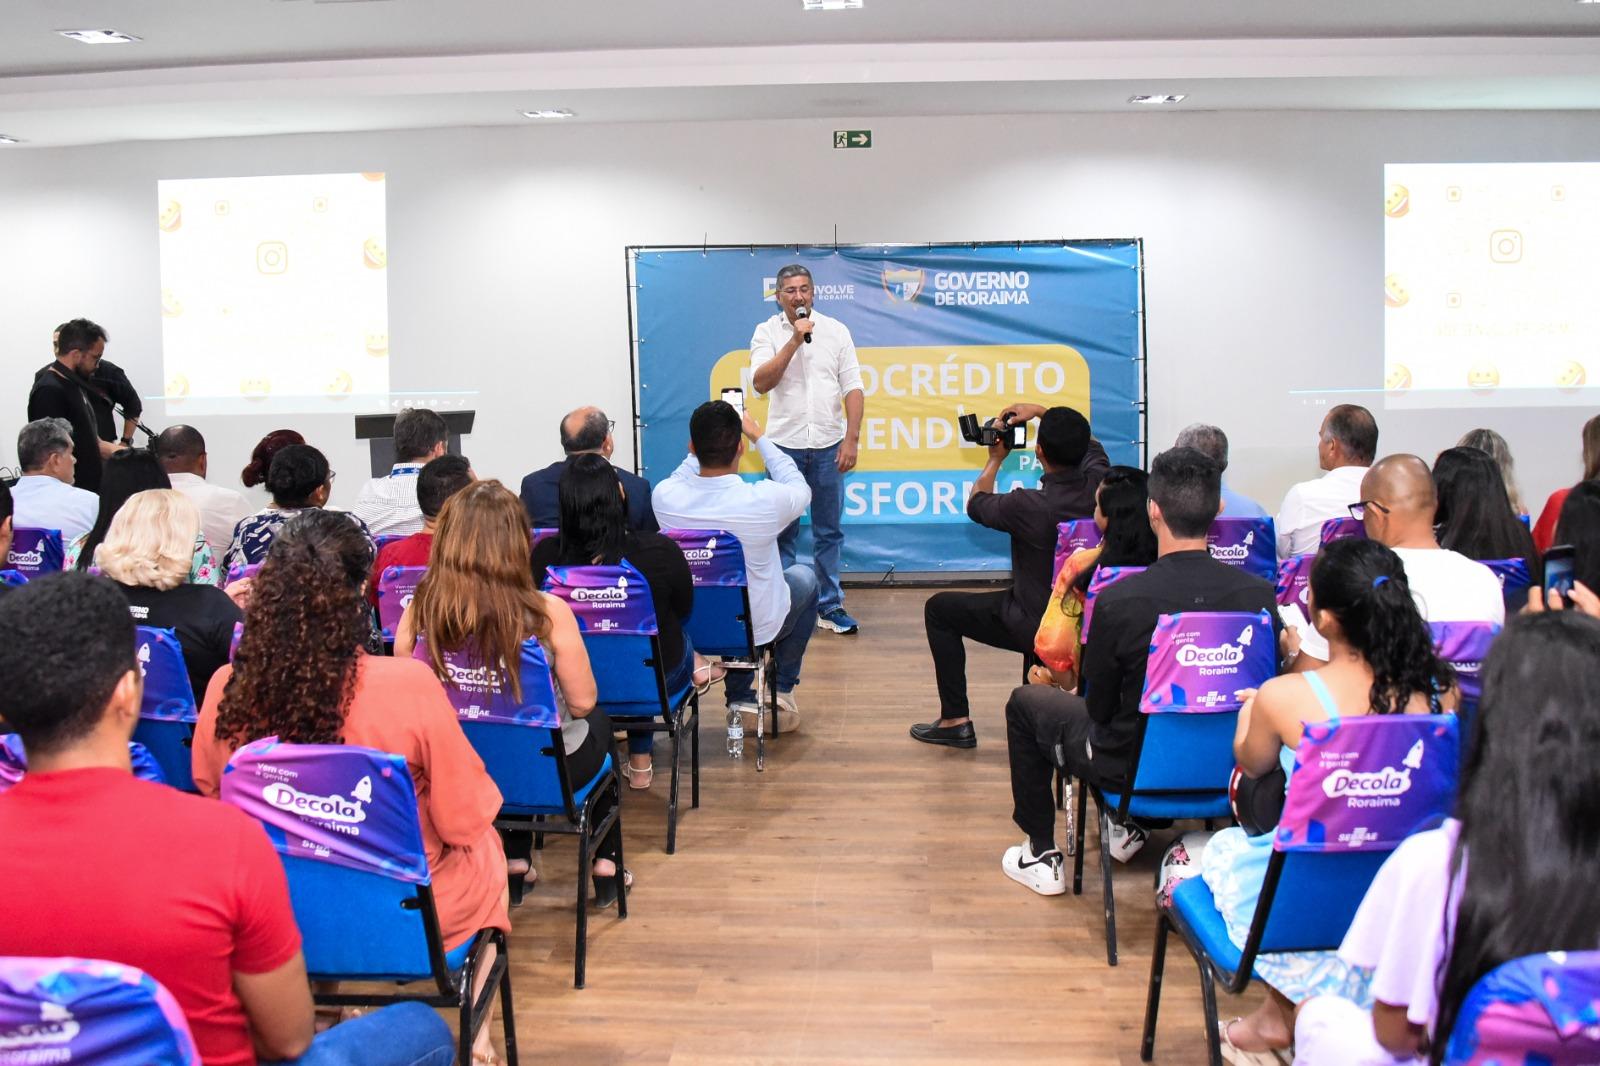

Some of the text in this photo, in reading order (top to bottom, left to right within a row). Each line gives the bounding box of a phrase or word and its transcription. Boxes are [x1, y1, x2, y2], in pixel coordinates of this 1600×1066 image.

[934, 271, 1029, 290] GOVERNO
[934, 291, 1029, 306] DE RORAIMA
[740, 354, 1065, 398] OCRÉDITO
[1020, 455, 1044, 471] PA
[9, 552, 38, 562] Decola
[685, 547, 709, 559] cola
[576, 589, 623, 600] Decola
[1184, 647, 1238, 662] Decola
[1199, 667, 1238, 676] Roraima
[257, 762, 298, 778] Vem com
[1333, 773, 1402, 793] Decola
[275, 788, 356, 817] Decola
[1347, 796, 1401, 808] Roraima
